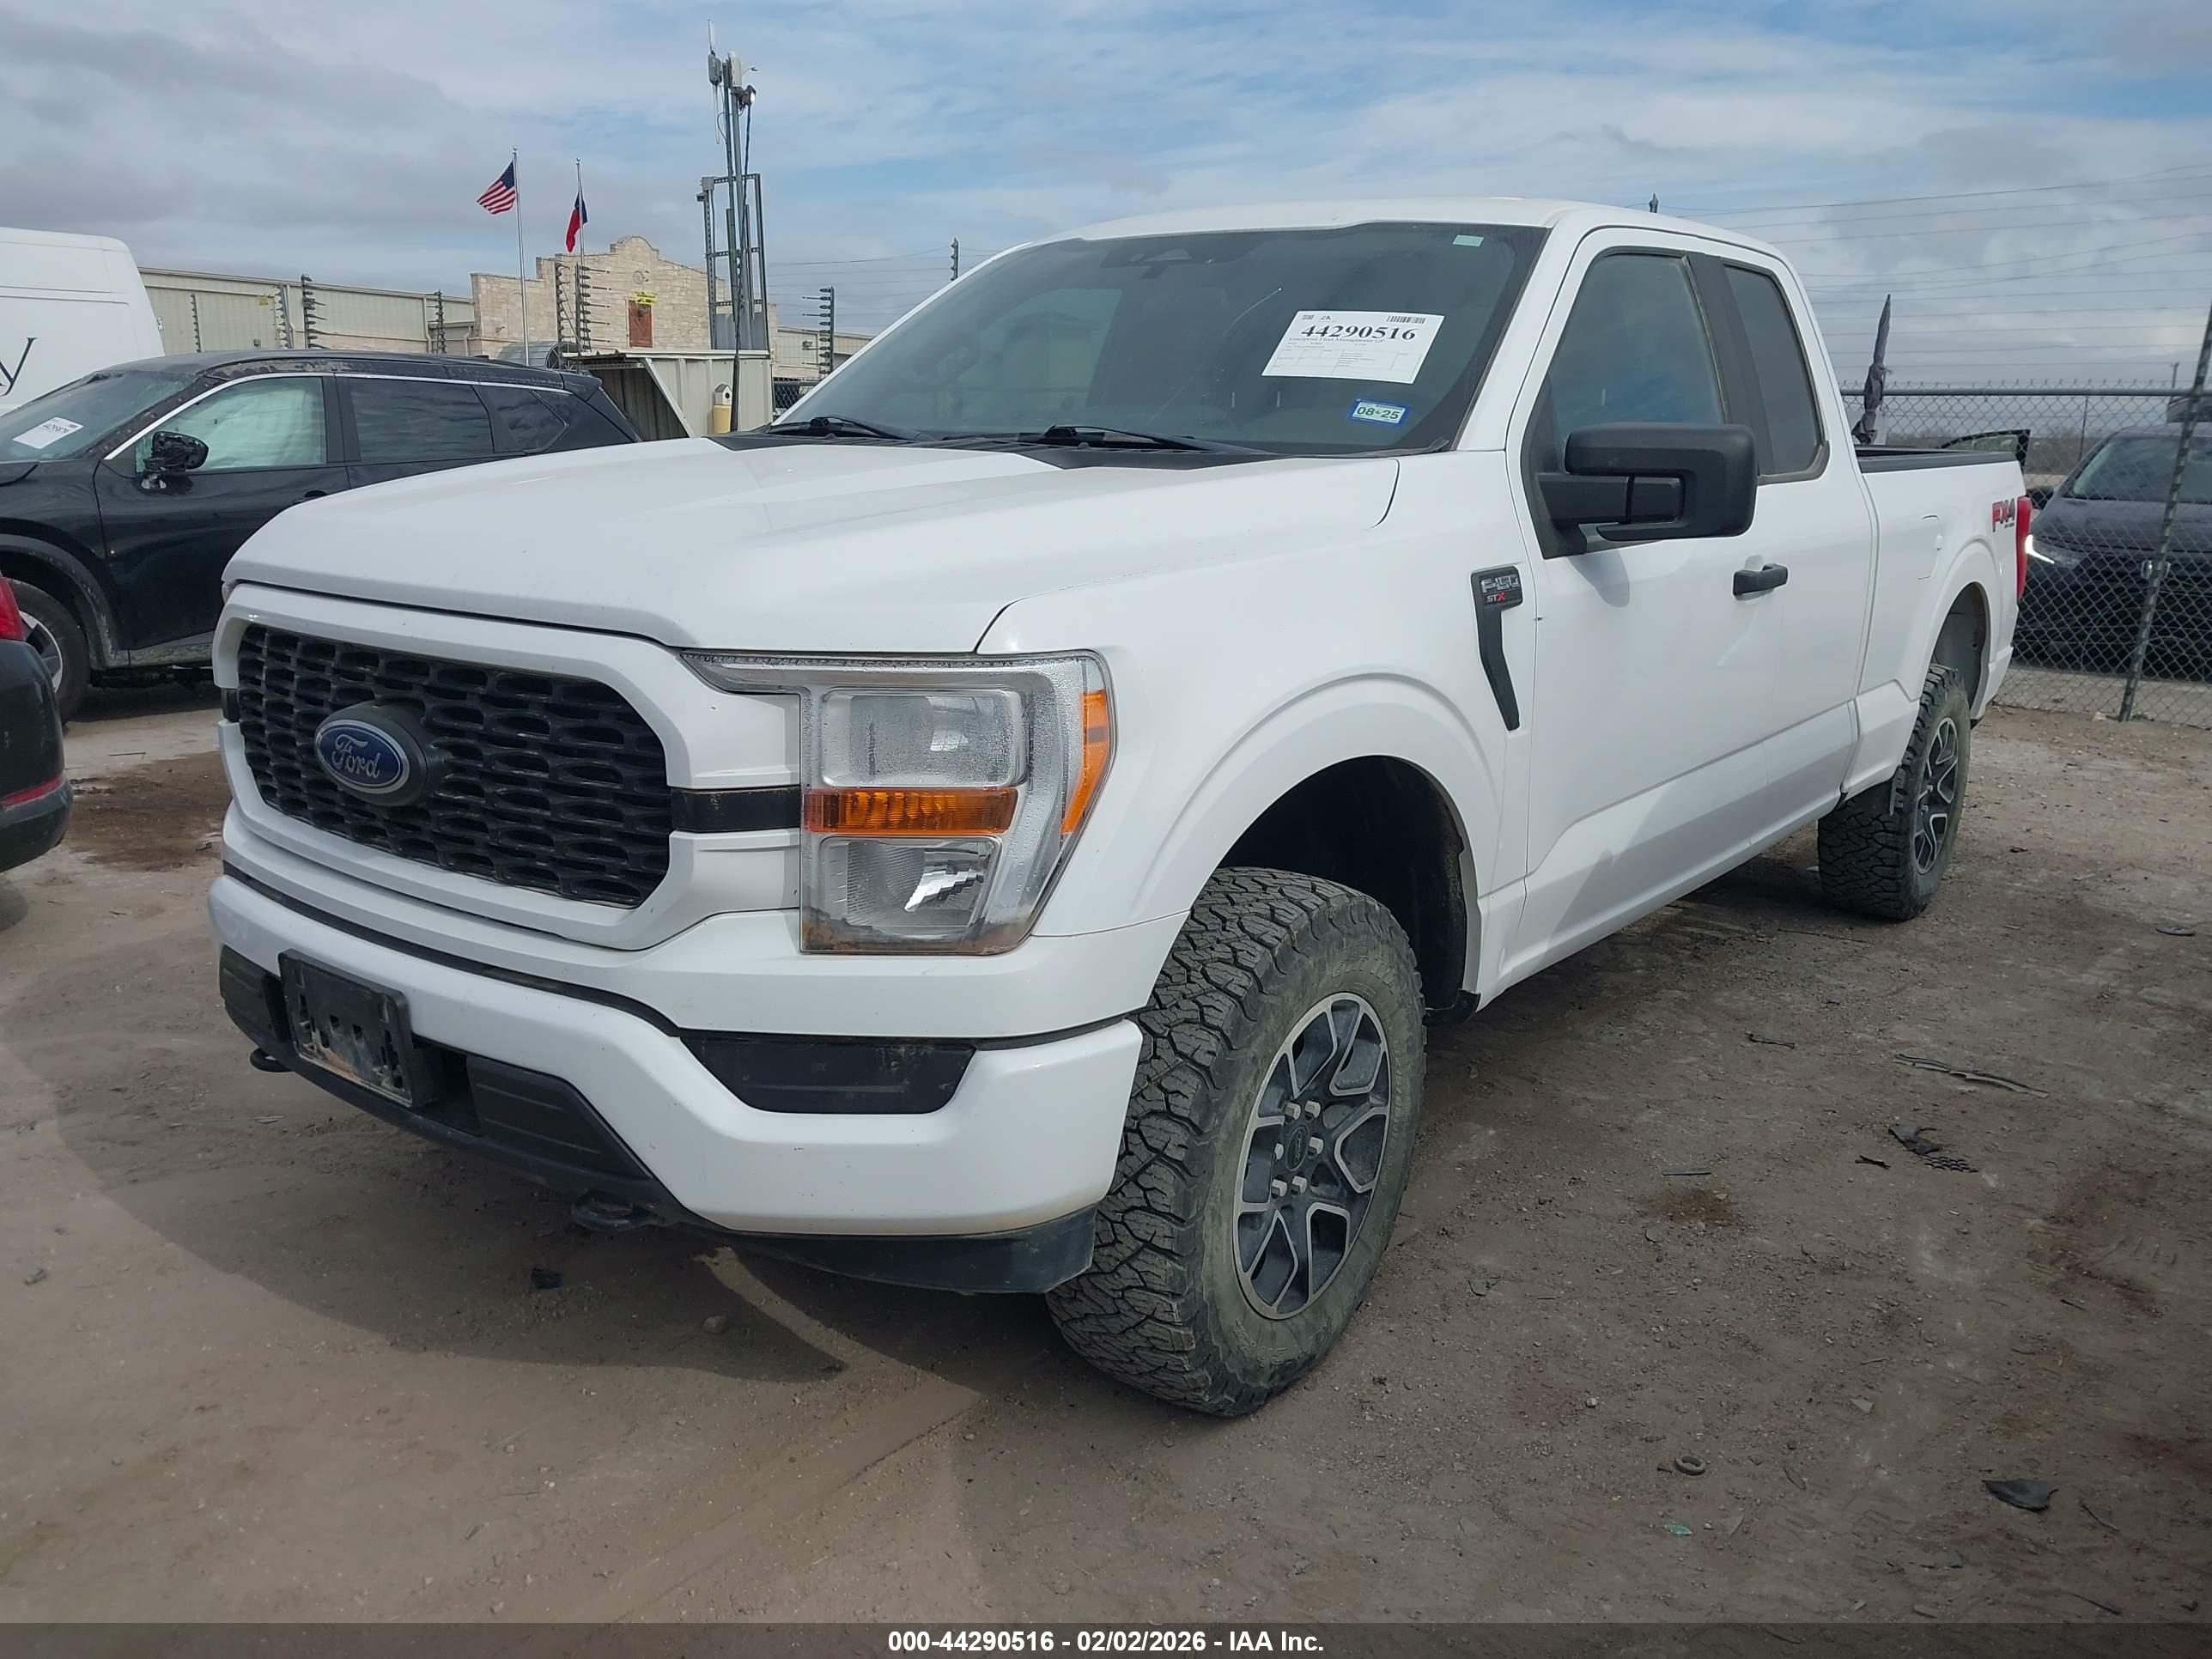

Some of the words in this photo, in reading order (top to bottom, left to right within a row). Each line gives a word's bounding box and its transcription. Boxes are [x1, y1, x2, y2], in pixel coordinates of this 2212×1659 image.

[1301, 325, 1420, 341] 44290516
[1357, 406, 1376, 416] 08
[1380, 410, 1401, 420] 25
[1991, 498, 2015, 533] FX4
[1486, 592, 1506, 603] STX
[331, 733, 381, 780] Ford
